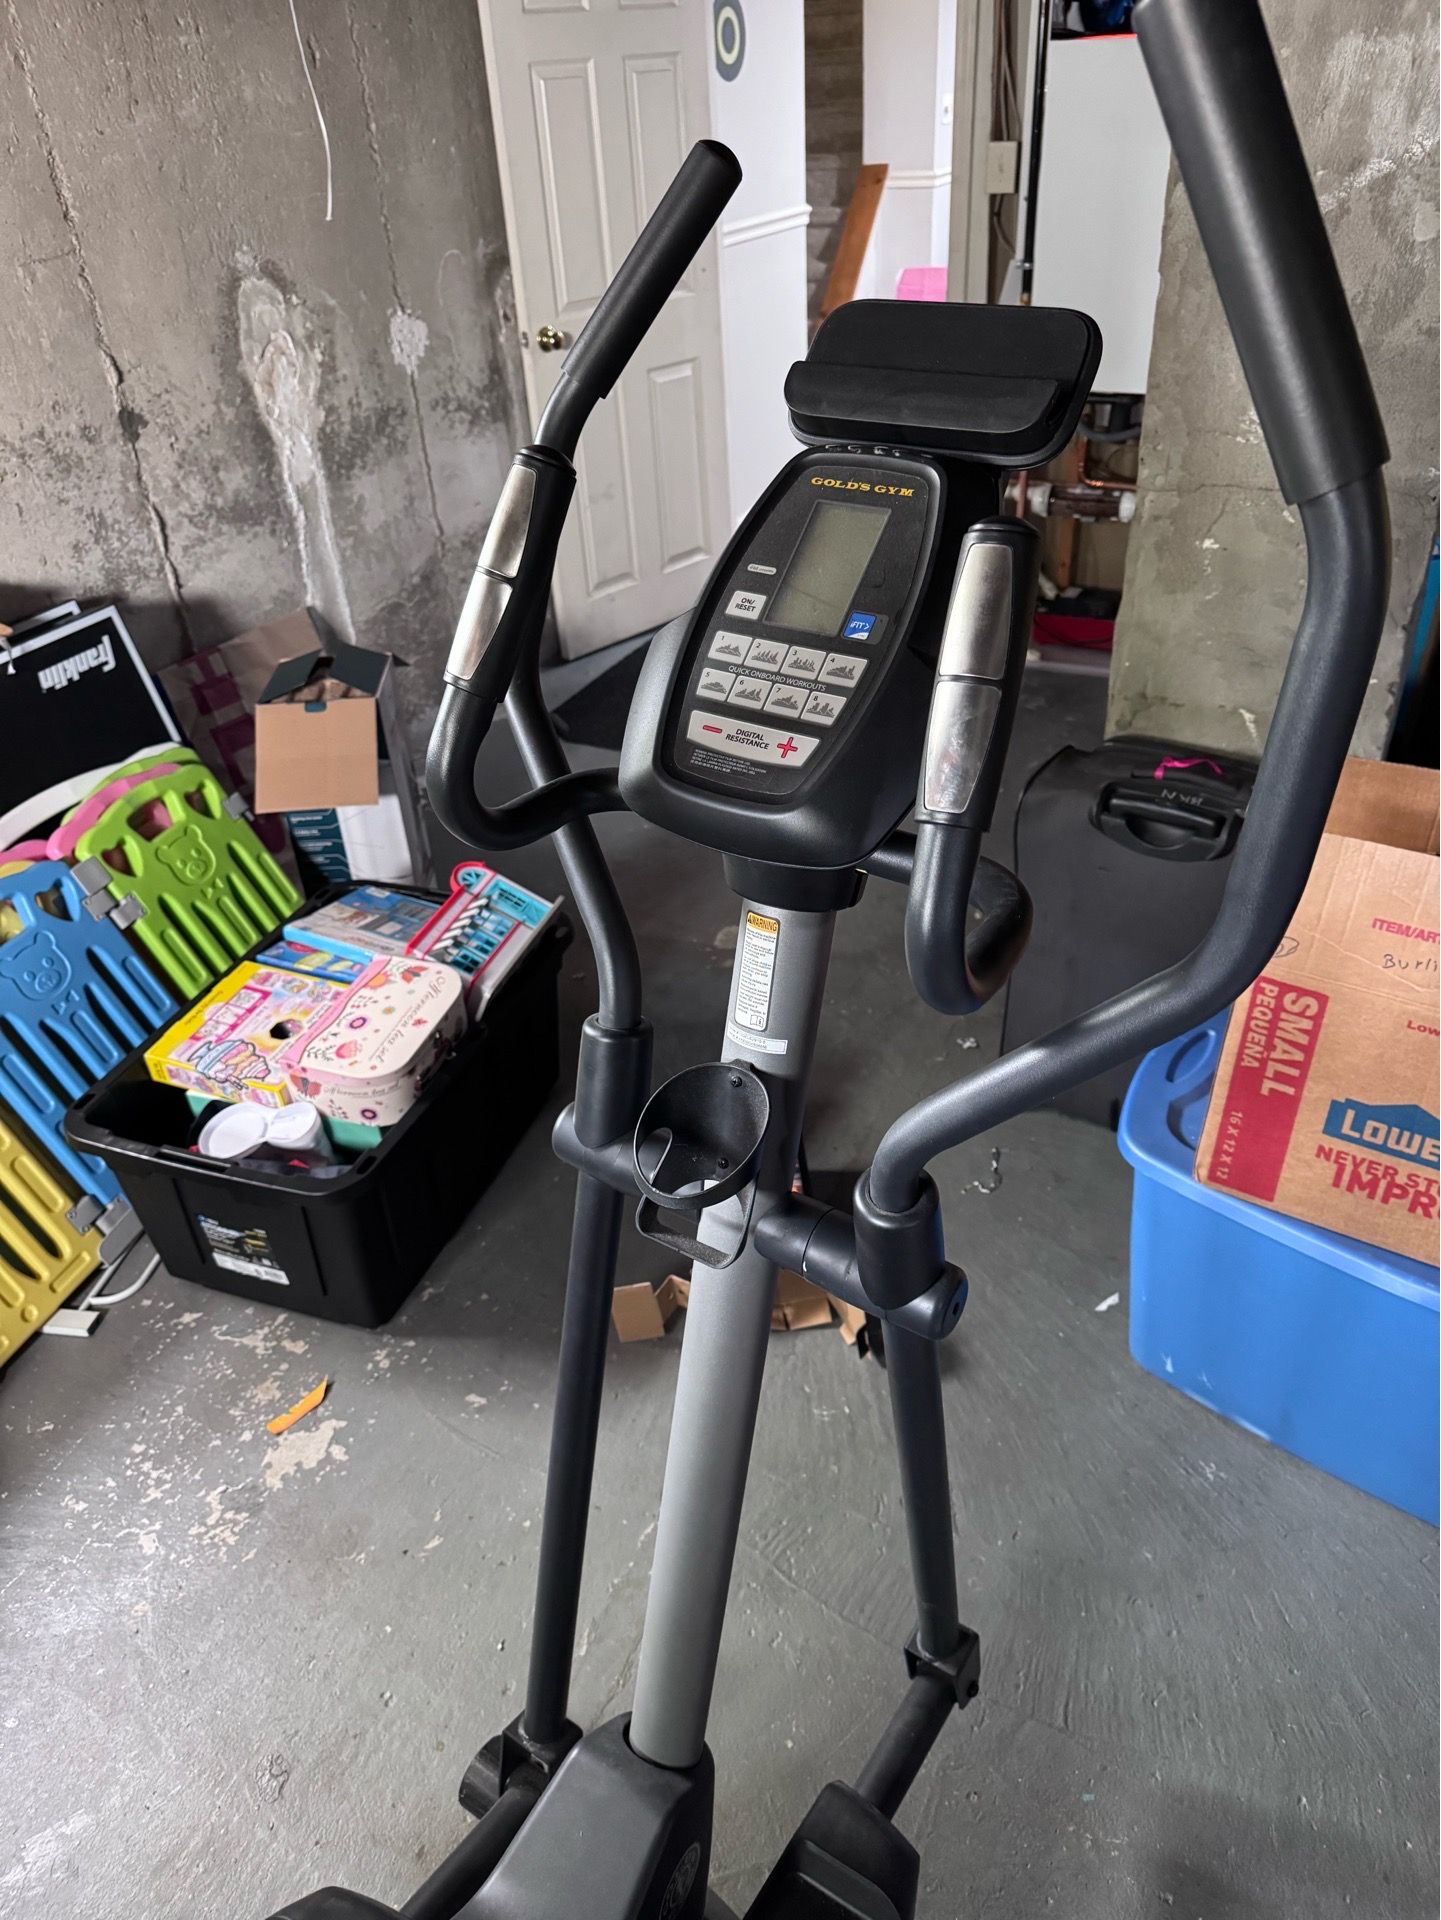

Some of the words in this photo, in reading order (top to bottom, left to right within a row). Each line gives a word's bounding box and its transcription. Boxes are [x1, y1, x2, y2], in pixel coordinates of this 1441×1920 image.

[811, 477, 871, 491] GOLD'S
[874, 485, 915, 497] GYM
[734, 603, 756, 612] RESET
[741, 597, 756, 605] ON/
[38, 634, 116, 691] franklin
[728, 665, 749, 675] QUICK
[750, 670, 786, 683] ONBOARD
[786, 677, 826, 691] WORKOUTS
[725, 734, 770, 750] RESISTANCE
[735, 728, 764, 741] DIGITAL
[751, 915, 778, 931] WARNING
[1240, 982, 1279, 1068] PEQUEÑA
[1259, 991, 1319, 1096] SMALL
[1230, 1111, 1243, 1125] 16
[1223, 1139, 1236, 1152] 12
[1216, 1166, 1229, 1179] 12
[1315, 1144, 1399, 1181] NEVER
[1404, 1173, 1440, 1197] ST
[1331, 1162, 1440, 1220] IMPR
